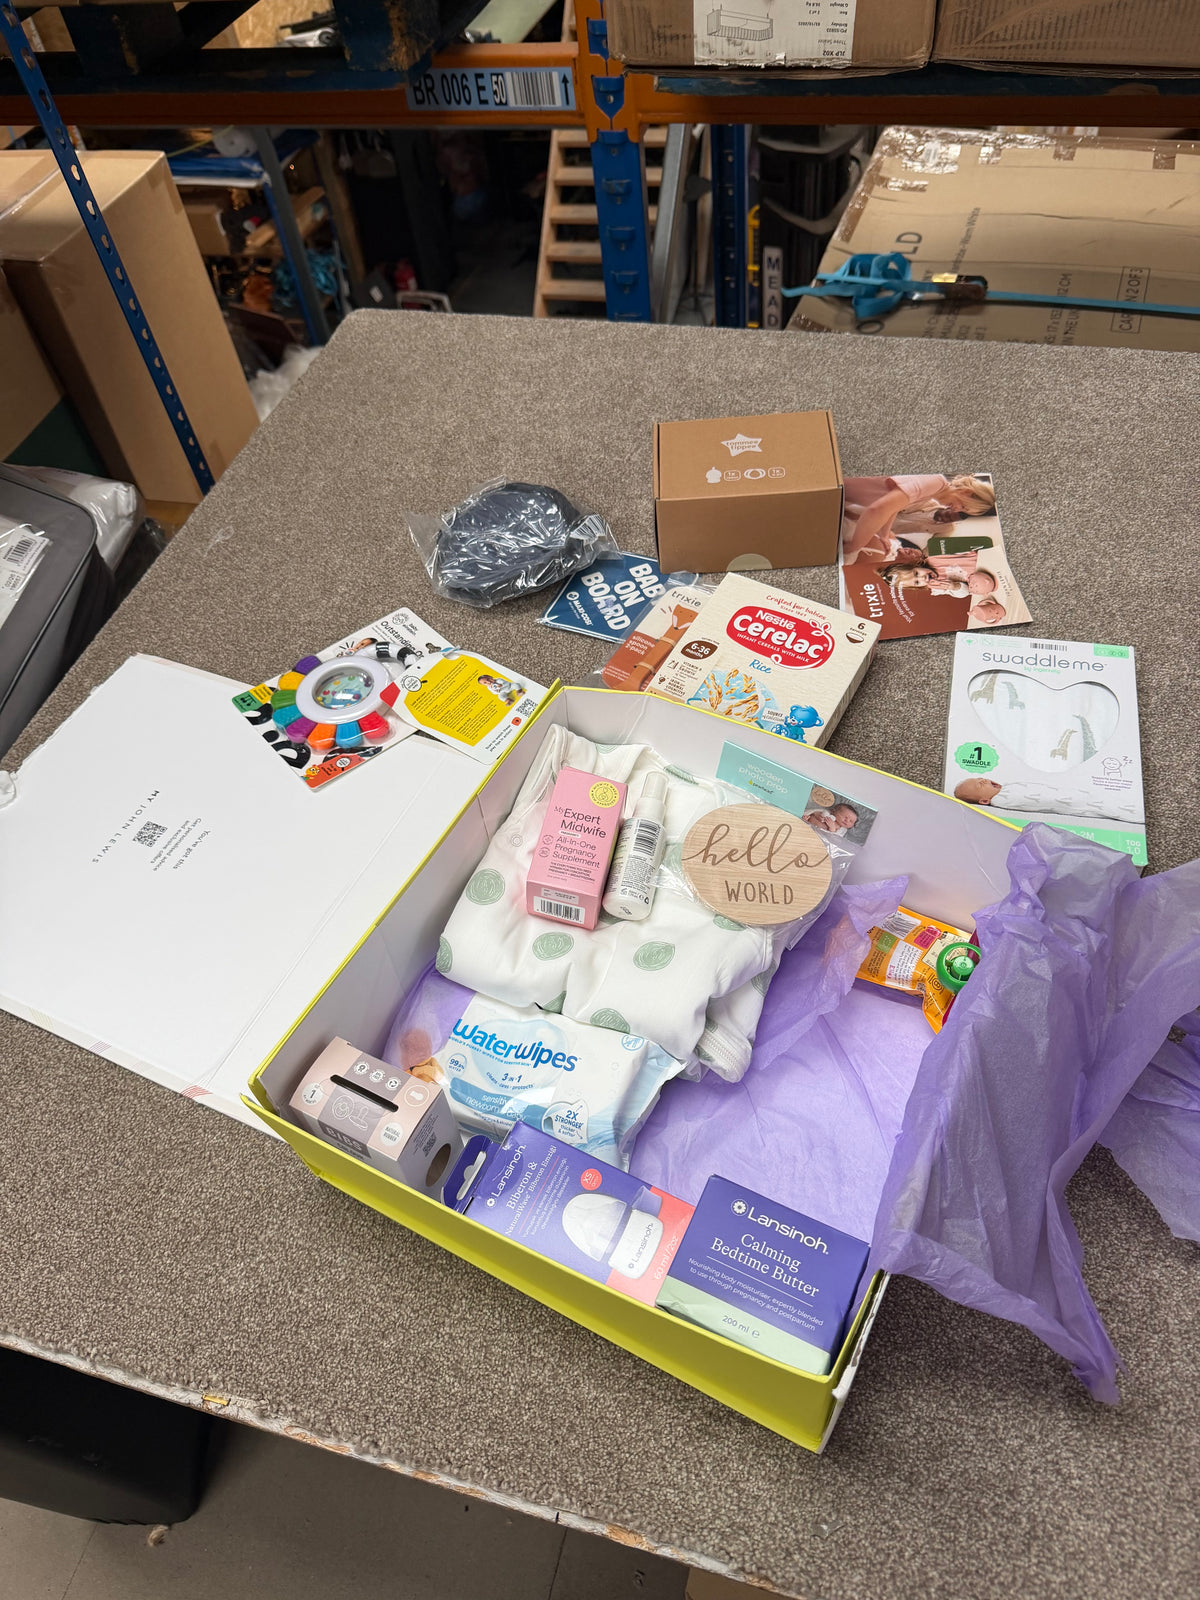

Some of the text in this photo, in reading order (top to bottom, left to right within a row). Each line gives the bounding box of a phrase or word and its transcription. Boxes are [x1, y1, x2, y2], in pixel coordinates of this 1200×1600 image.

[413, 73, 508, 106] BR 006 E 50
[1128, 275, 1142, 288] OF
[629, 563, 666, 598] BAB
[581, 571, 631, 630] BOARD
[614, 581, 645, 608] ON
[671, 590, 701, 607] trixie
[766, 595, 827, 620] Crafted for babies
[860, 584, 884, 617] trixie
[573, 600, 592, 626] MAXI-COSI
[629, 640, 648, 650] spoon
[691, 643, 710, 655] 6-36
[733, 614, 824, 659] Cerelac
[737, 633, 809, 663] INFANT CEREALS WITH MILK
[749, 659, 772, 674] Rice
[738, 766, 789, 795] photo prop
[748, 762, 784, 786] wooden
[92, 790, 160, 863] MY JOHN LEWIS
[554, 806, 602, 825] My Expert
[166, 826, 193, 857] personalised
[560, 819, 606, 839] Midwife
[173, 829, 211, 870] You've got this
[554, 844, 596, 860] Pregnancy
[556, 836, 596, 851] All-In-One
[681, 823, 830, 874] hello
[552, 851, 600, 869] Supplement
[724, 880, 794, 906] WORLD
[502, 1073, 509, 1081] 3
[465, 1096, 500, 1113] newborn
[566, 1110, 579, 1120] 2X
[555, 1115, 584, 1130] STRONGER
[560, 1124, 576, 1133] thicker
[326, 1126, 362, 1151] BIBS
[383, 1132, 398, 1142] RUBBER
[491, 1142, 526, 1198] Lansinoh
[528, 1166, 546, 1192] Biberon
[582, 1171, 593, 1184] XS
[505, 1160, 538, 1210] Biberon &
[631, 1222, 654, 1264] Lansinoh
[748, 1206, 828, 1254] Lansinoh
[740, 1233, 802, 1272] Calming
[654, 1266, 663, 1280] 60
[710, 1237, 819, 1298] Bedtime Butter
[688, 1258, 824, 1326] Nourishing body moisturiser, expertly blended
[690, 1267, 816, 1331] to use through pregnancy and postpartum
[722, 1315, 750, 1334] 200 ml
